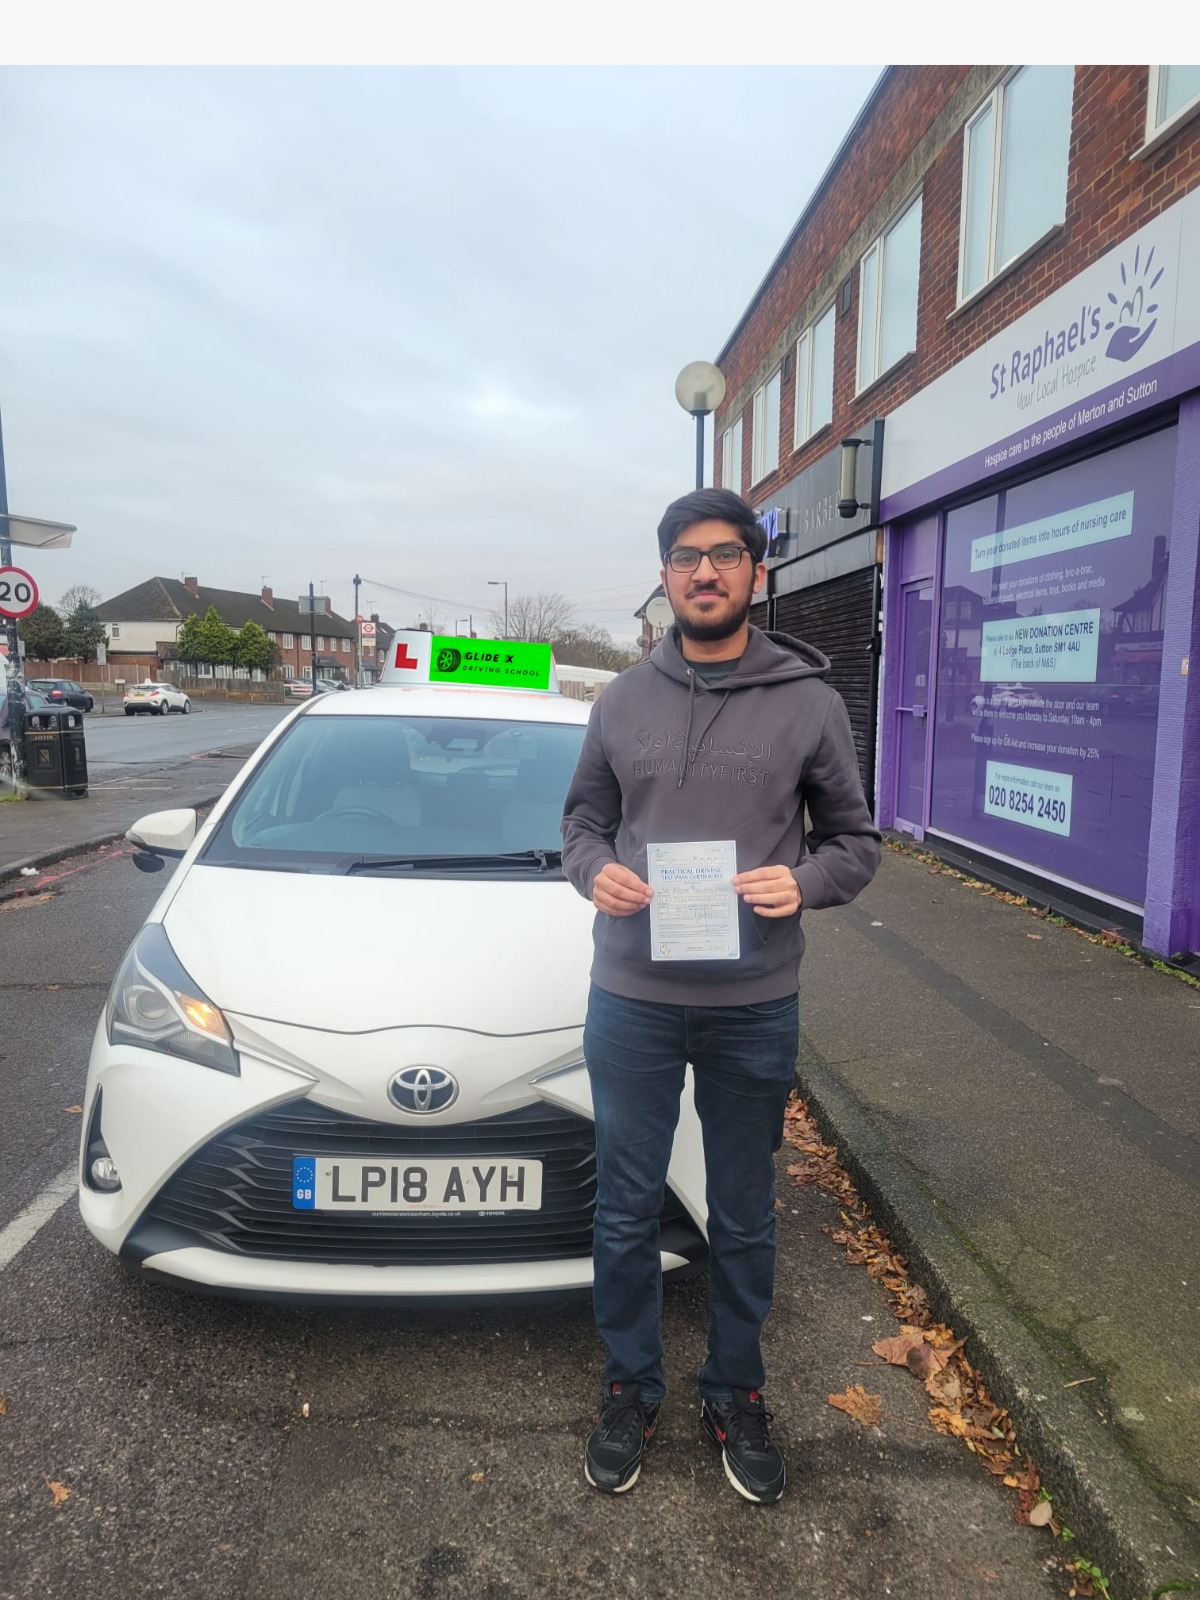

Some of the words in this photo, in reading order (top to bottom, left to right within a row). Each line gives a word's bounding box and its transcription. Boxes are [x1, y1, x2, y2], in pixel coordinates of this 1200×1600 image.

[990, 363, 1006, 399] St
[1010, 306, 1100, 387] Raphael's
[1016, 390, 1034, 410] Your
[1036, 368, 1058, 402] Local
[1062, 355, 1096, 388] Hospice
[985, 449, 1007, 468] Hospice
[1008, 442, 1022, 457] care
[1024, 438, 1030, 451] to
[1031, 432, 1041, 448] the
[1042, 420, 1066, 446] people
[1068, 412, 1077, 430] of
[1078, 404, 1106, 426] Merton
[1108, 390, 1124, 413] and
[1126, 380, 1158, 404] Sutton
[974, 550, 986, 560] Turn
[986, 545, 998, 558] your
[998, 537, 1020, 552] donated
[1021, 534, 1036, 546] items
[1038, 530, 1050, 542] into
[1052, 525, 1070, 540] hours
[1072, 520, 1079, 533] of
[1080, 514, 1108, 530] nursing
[1110, 510, 1126, 522] care
[0, 582, 31, 603] 20
[1062, 582, 1076, 592] books
[1077, 579, 1087, 590] and
[1089, 576, 1105, 588] media
[1015, 628, 1028, 640] NEW
[1030, 624, 1063, 638] DONATION
[1065, 622, 1094, 636] CENTRE
[395, 644, 418, 669] L
[465, 652, 499, 662] GLIDE
[506, 655, 514, 663] X
[1003, 645, 1017, 657] Lodge
[1019, 644, 1033, 654] Place,
[1035, 643, 1052, 653] Sutton
[1054, 642, 1066, 652] SM1
[1068, 641, 1080, 652] 4AU
[505, 668, 540, 676] SCHOOL
[1011, 658, 1022, 670] (The
[1023, 659, 1034, 668] back
[1035, 658, 1040, 668] of
[1041, 657, 1056, 670] M&S)
[1054, 700, 1065, 709] door
[1066, 700, 1076, 710] and
[1076, 702, 1085, 710] our
[1086, 701, 1099, 711] team
[999, 710, 1015, 719] welcome
[1016, 712, 1024, 722] you
[1025, 711, 1041, 723] Monday
[1042, 712, 1047, 722] to
[1048, 713, 1069, 726] Saturday
[1071, 714, 1085, 725] 10am
[1090, 715, 1102, 728] 4pm
[1018, 740, 1026, 749] and
[1027, 741, 1046, 752] increase
[1047, 744, 1057, 754] your
[1058, 744, 1079, 756] donation
[1080, 746, 1086, 759] by
[1087, 747, 1099, 760] 25%
[1044, 782, 1053, 791] team
[989, 785, 1006, 808] 020
[1009, 790, 1034, 815] 8254
[1037, 796, 1066, 823] 2450
[332, 1166, 427, 1202] LP18
[442, 1166, 525, 1202] AYH
[297, 1189, 312, 1199] GB
